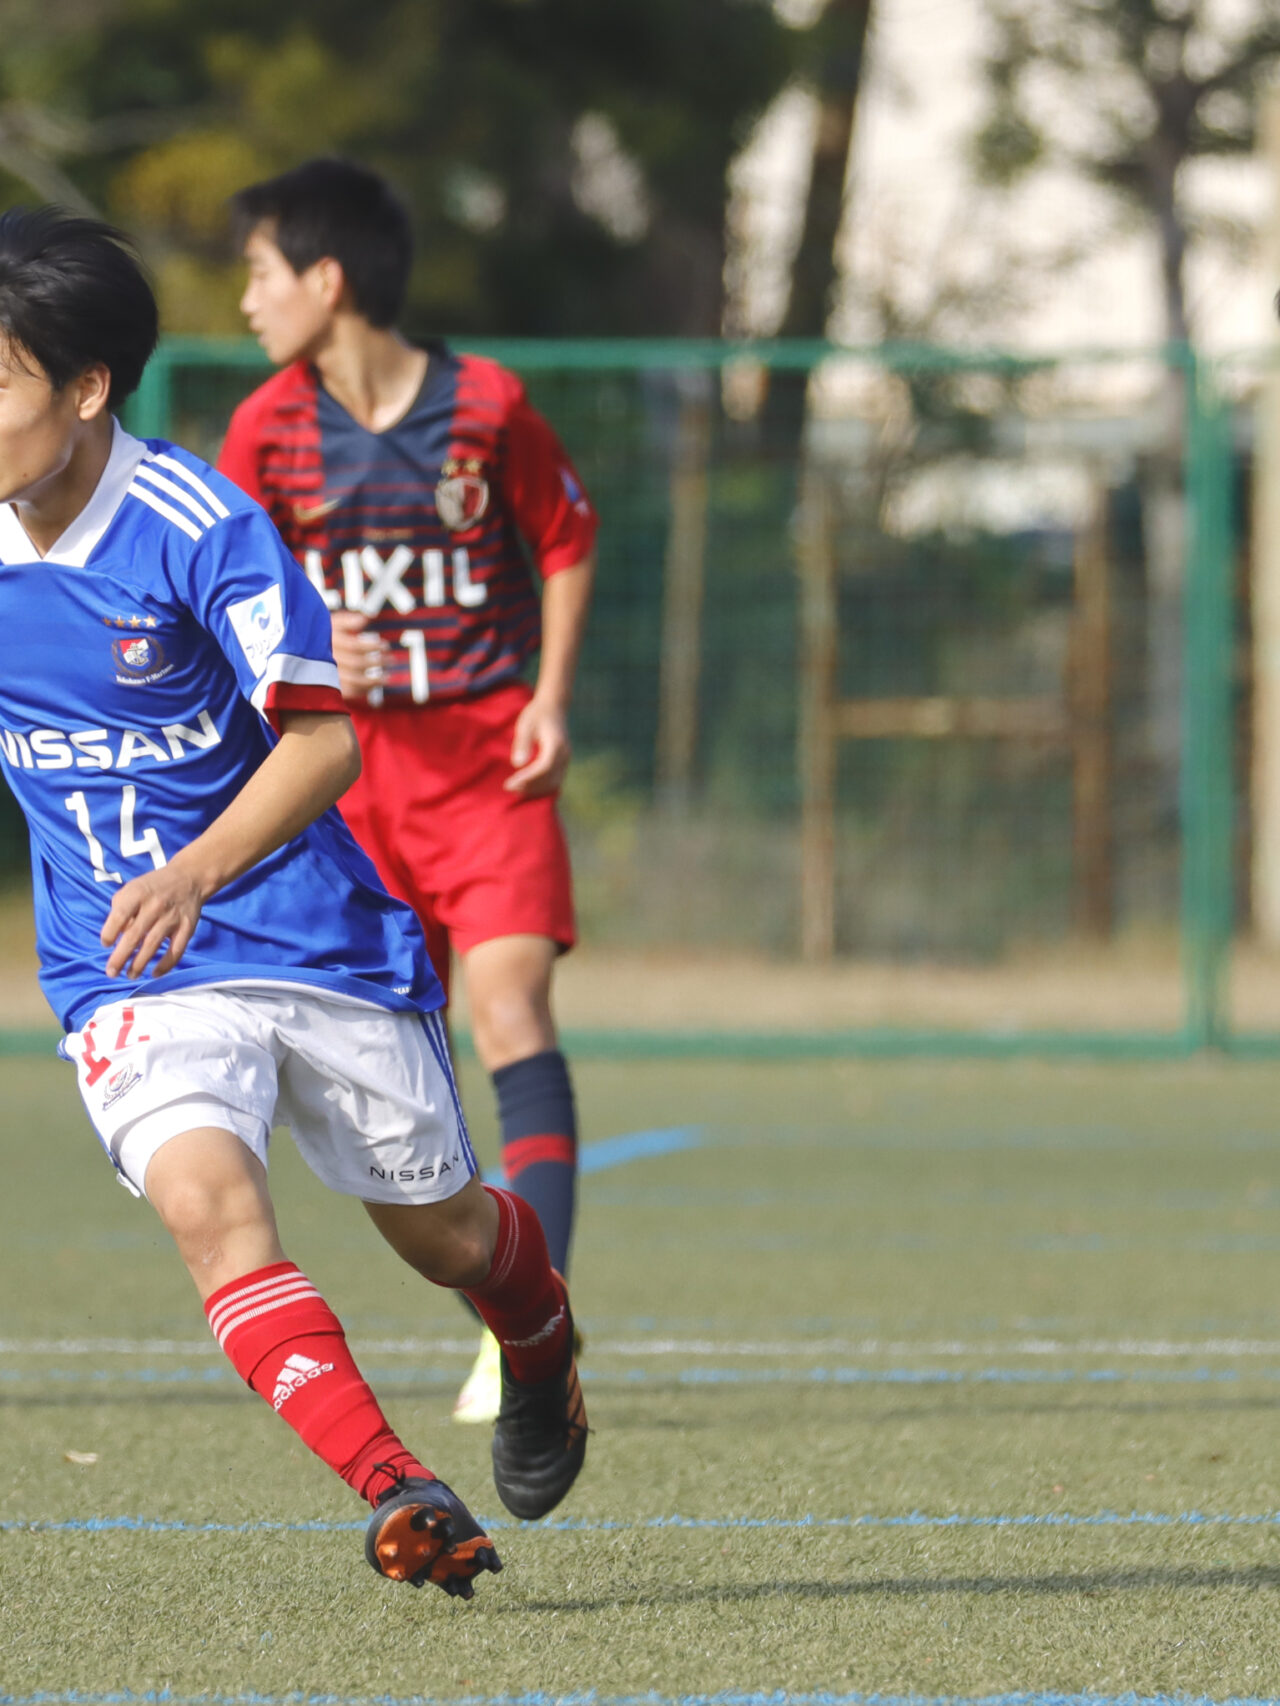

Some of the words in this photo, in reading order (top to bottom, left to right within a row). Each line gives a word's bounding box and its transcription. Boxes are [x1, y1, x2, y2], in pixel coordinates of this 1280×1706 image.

[305, 545, 487, 617] LIXIL
[64, 785, 168, 884] 14
[273, 1362, 335, 1412] adidas
